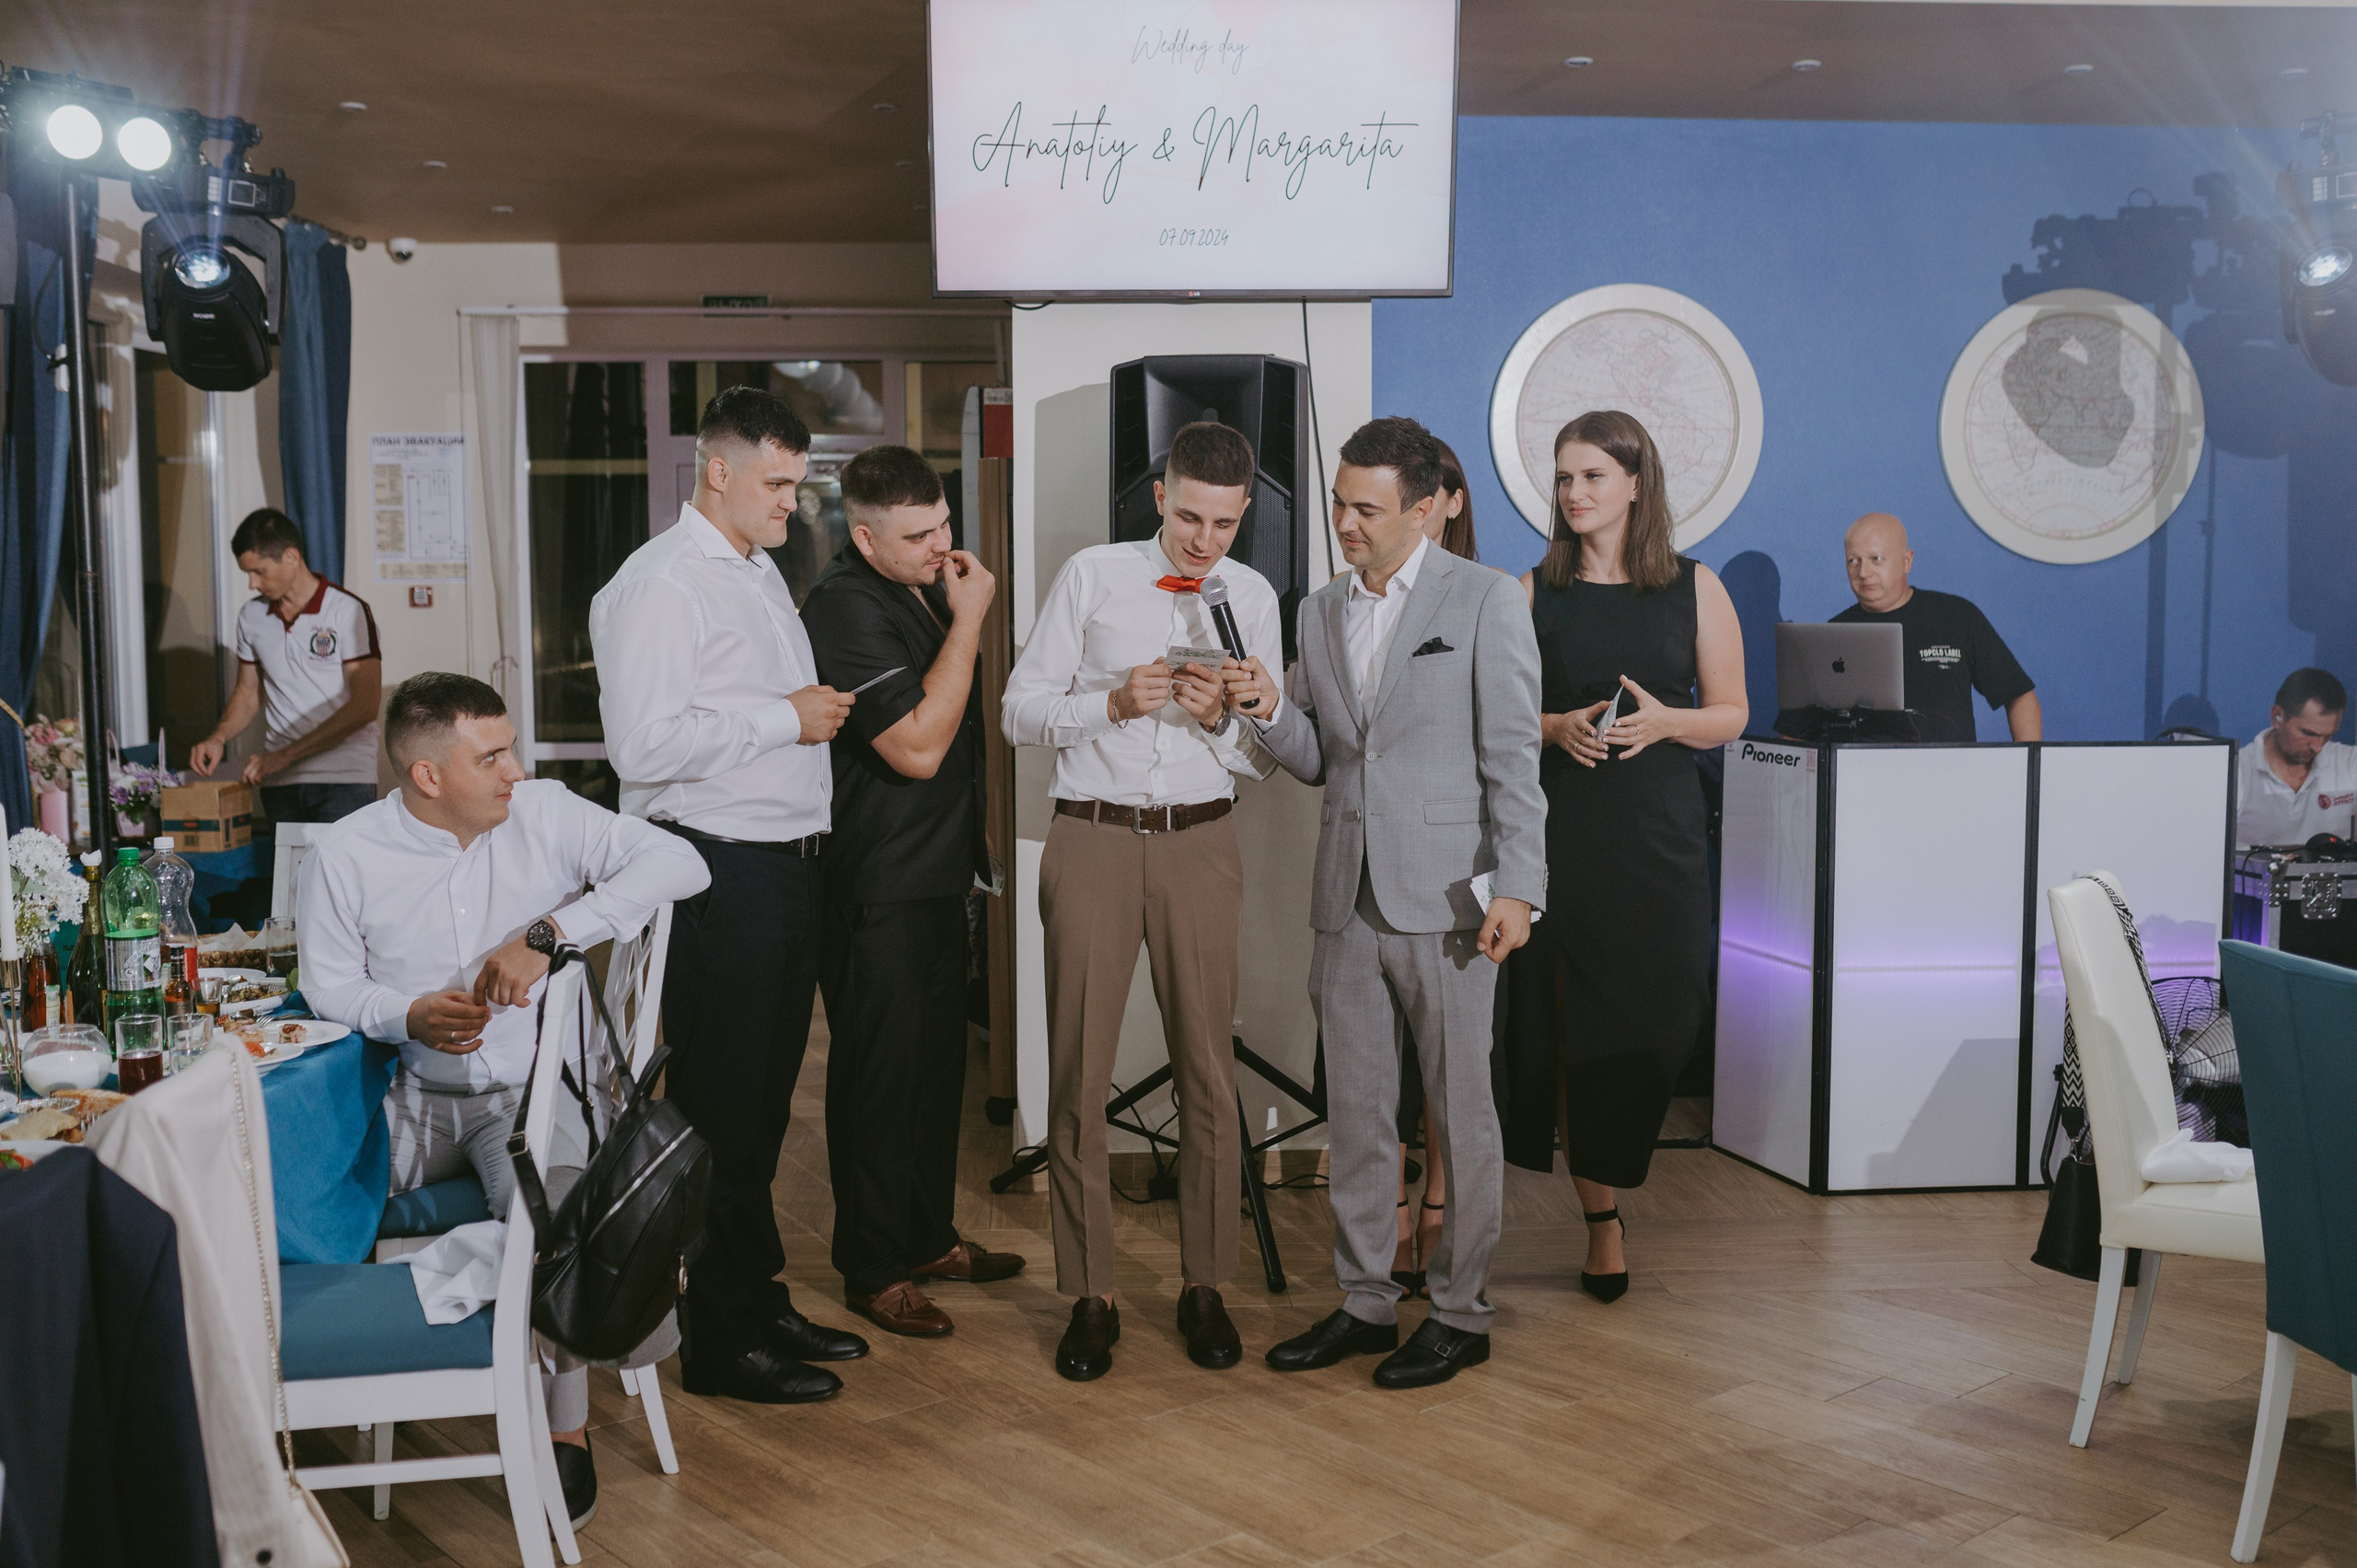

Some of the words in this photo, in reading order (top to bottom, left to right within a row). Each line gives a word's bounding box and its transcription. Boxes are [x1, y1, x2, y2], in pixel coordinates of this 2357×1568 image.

[1132, 26, 1213, 74] Wedding
[1218, 29, 1249, 75] day
[1152, 127, 1176, 162] &
[1192, 104, 1419, 201] Margarita
[1159, 228, 1229, 246] 07.09.2024
[1741, 743, 1801, 767] Pioneer
